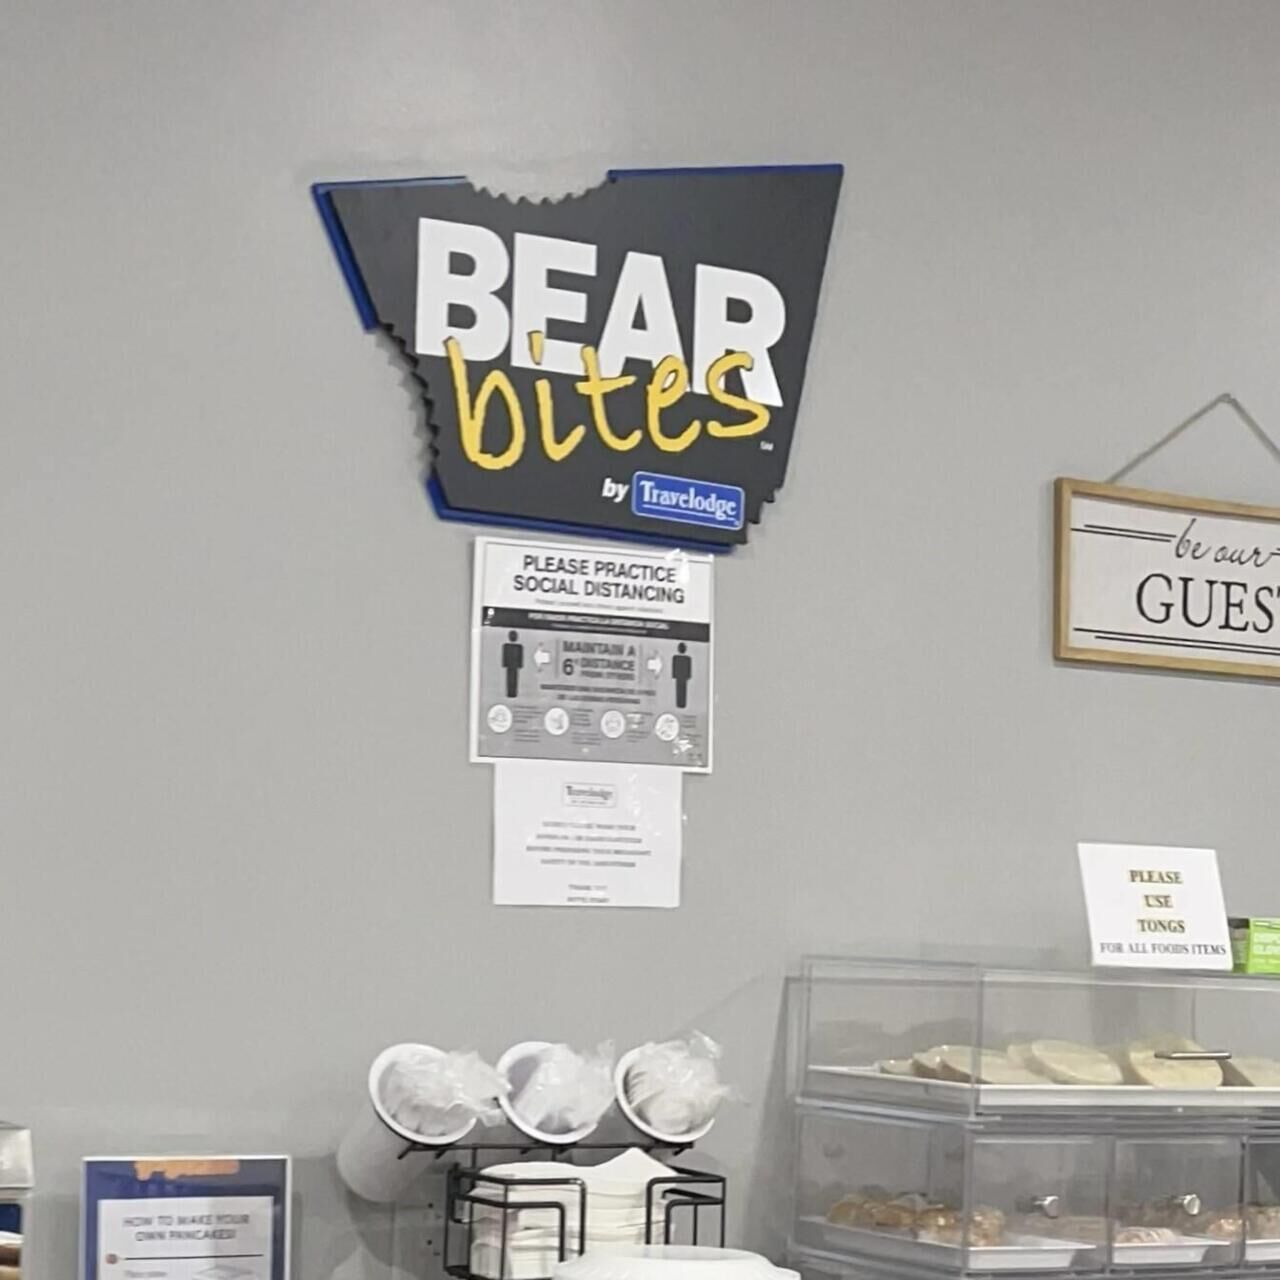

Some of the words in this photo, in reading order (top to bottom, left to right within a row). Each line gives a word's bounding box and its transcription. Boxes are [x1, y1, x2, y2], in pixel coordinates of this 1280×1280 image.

[415, 217, 785, 407] BEAR
[443, 331, 770, 470] bites
[601, 477, 630, 503] by
[639, 480, 737, 521] Travelodge
[1175, 517, 1212, 560] be
[1213, 545, 1272, 568] our
[523, 554, 591, 576] PLEASE
[594, 560, 677, 584] PRACTICE
[513, 574, 579, 596] SOCIAL
[584, 580, 685, 604] DISTANCING
[562, 640, 624, 656] MAINTAIN
[1128, 869, 1183, 884] PLEASE
[1143, 894, 1174, 909] USE
[1137, 918, 1186, 934] TONGS
[1099, 941, 1124, 954] FOR
[1128, 942, 1149, 954] ALL
[1151, 943, 1189, 955] FOODS
[1191, 943, 1226, 956] ITEMS
[122, 1216, 153, 1228] HOW
[157, 1215, 174, 1226] TO
[177, 1214, 213, 1226] MAKE
[215, 1213, 250, 1225] YOUR
[134, 1230, 166, 1242] OWN
